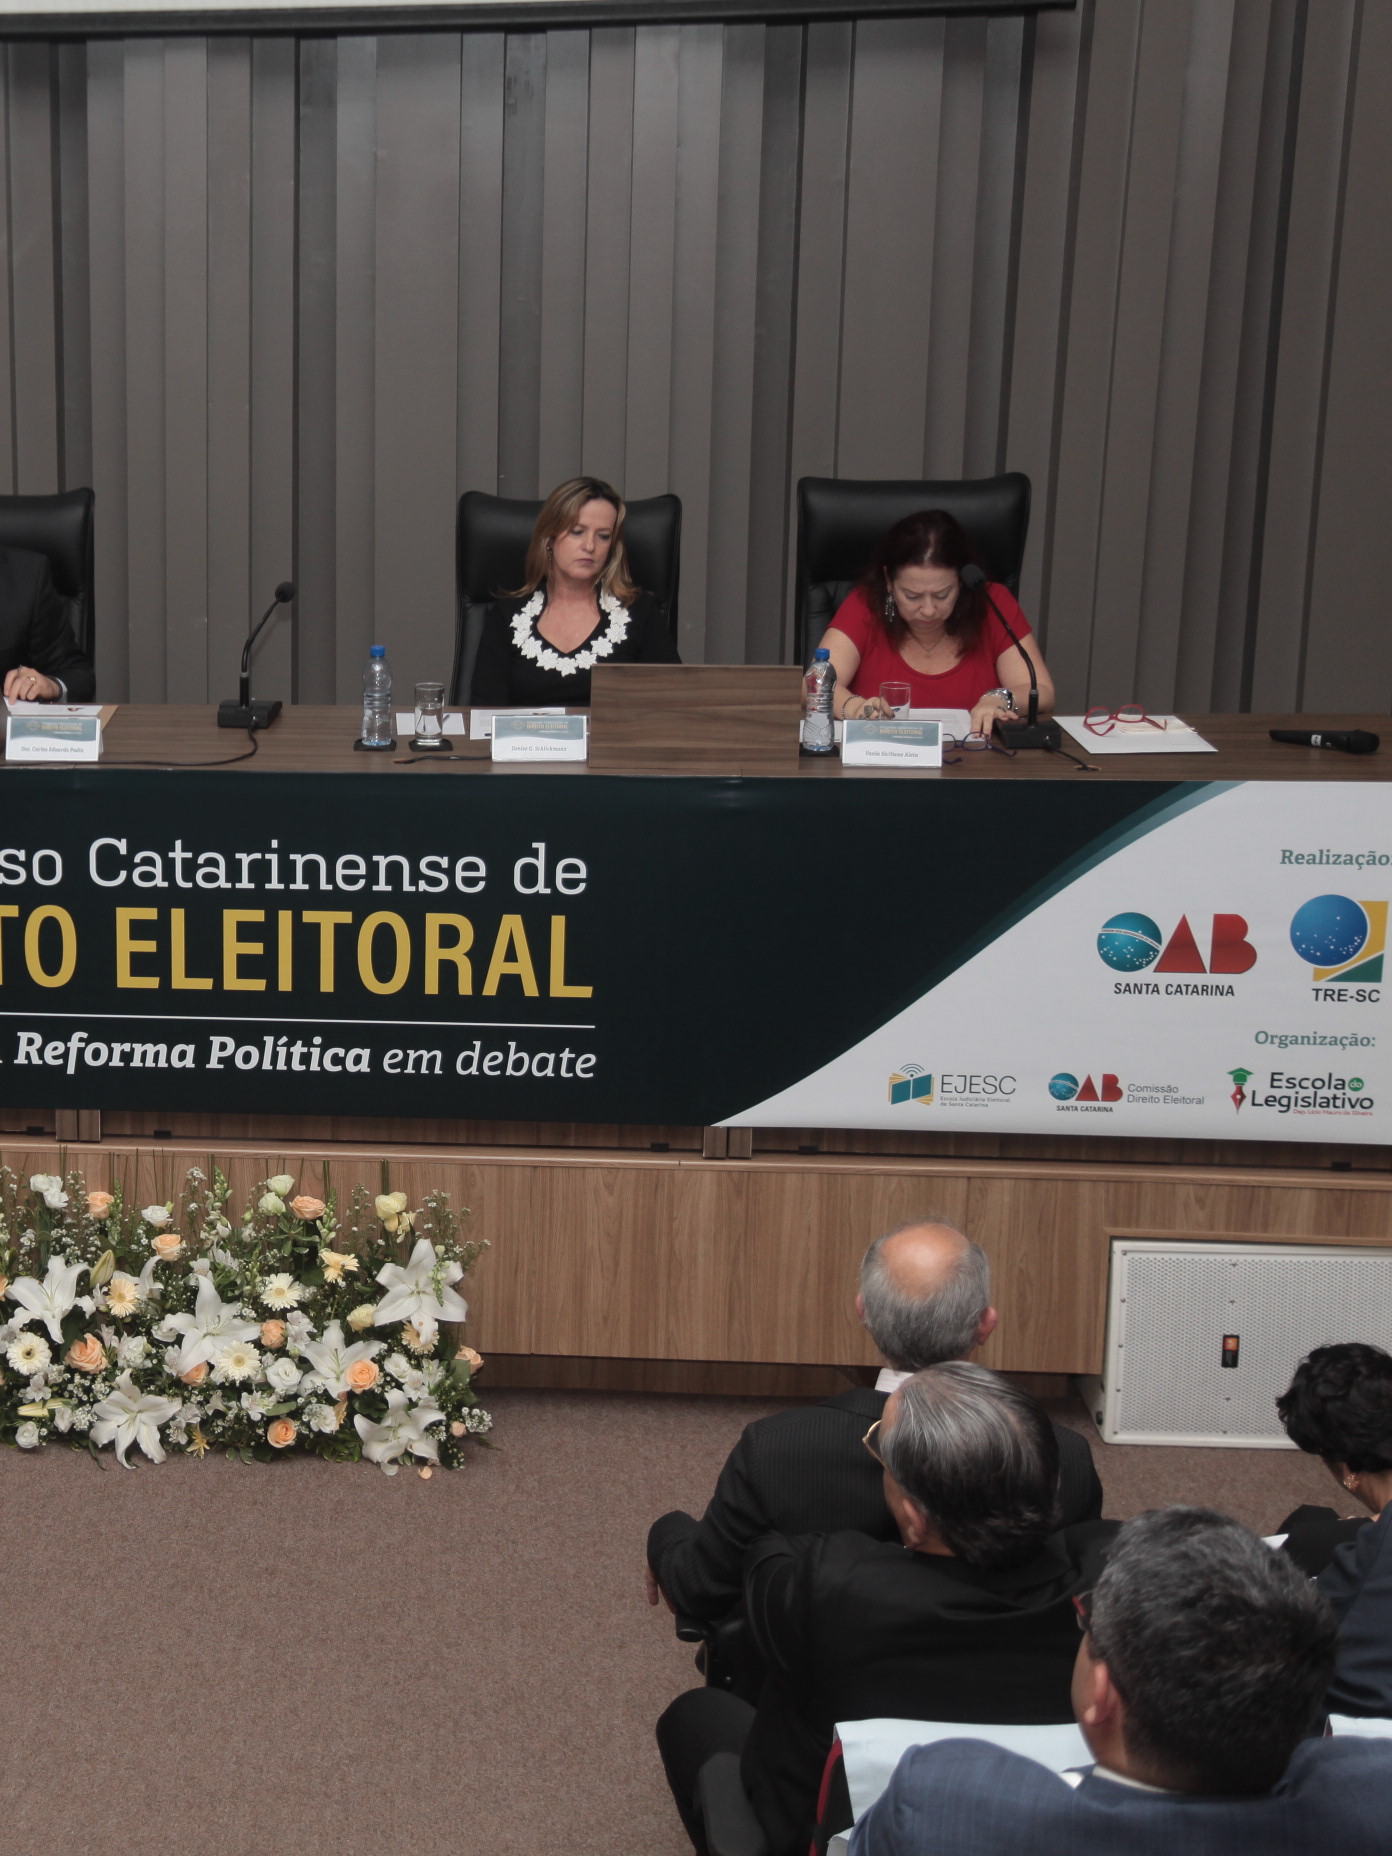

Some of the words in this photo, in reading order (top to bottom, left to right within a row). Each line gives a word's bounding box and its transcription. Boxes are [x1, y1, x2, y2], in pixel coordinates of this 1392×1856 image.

[88, 837, 487, 894] Catarinense
[513, 842, 587, 895] de
[115, 906, 594, 999] ELEITORAL
[1097, 912, 1258, 975] OAB
[1114, 982, 1160, 996] SANTA
[1165, 983, 1235, 997] CATARINA
[1311, 988, 1381, 1003] TRE-SC
[1254, 1030, 1376, 1051] Organização:
[13, 1031, 196, 1075] Reforma
[205, 1035, 371, 1073] Política
[382, 1048, 443, 1075] em
[455, 1040, 597, 1079] debate
[940, 1074, 1017, 1095] EJESC
[1048, 1072, 1124, 1102] OAB
[1127, 1083, 1179, 1094] Comissão
[1269, 1071, 1347, 1090] Escola
[1349, 1079, 1363, 1089] do
[1127, 1094, 1160, 1104] Direito
[1163, 1094, 1205, 1105] Eleitoral
[1251, 1090, 1374, 1114] Legislativo
